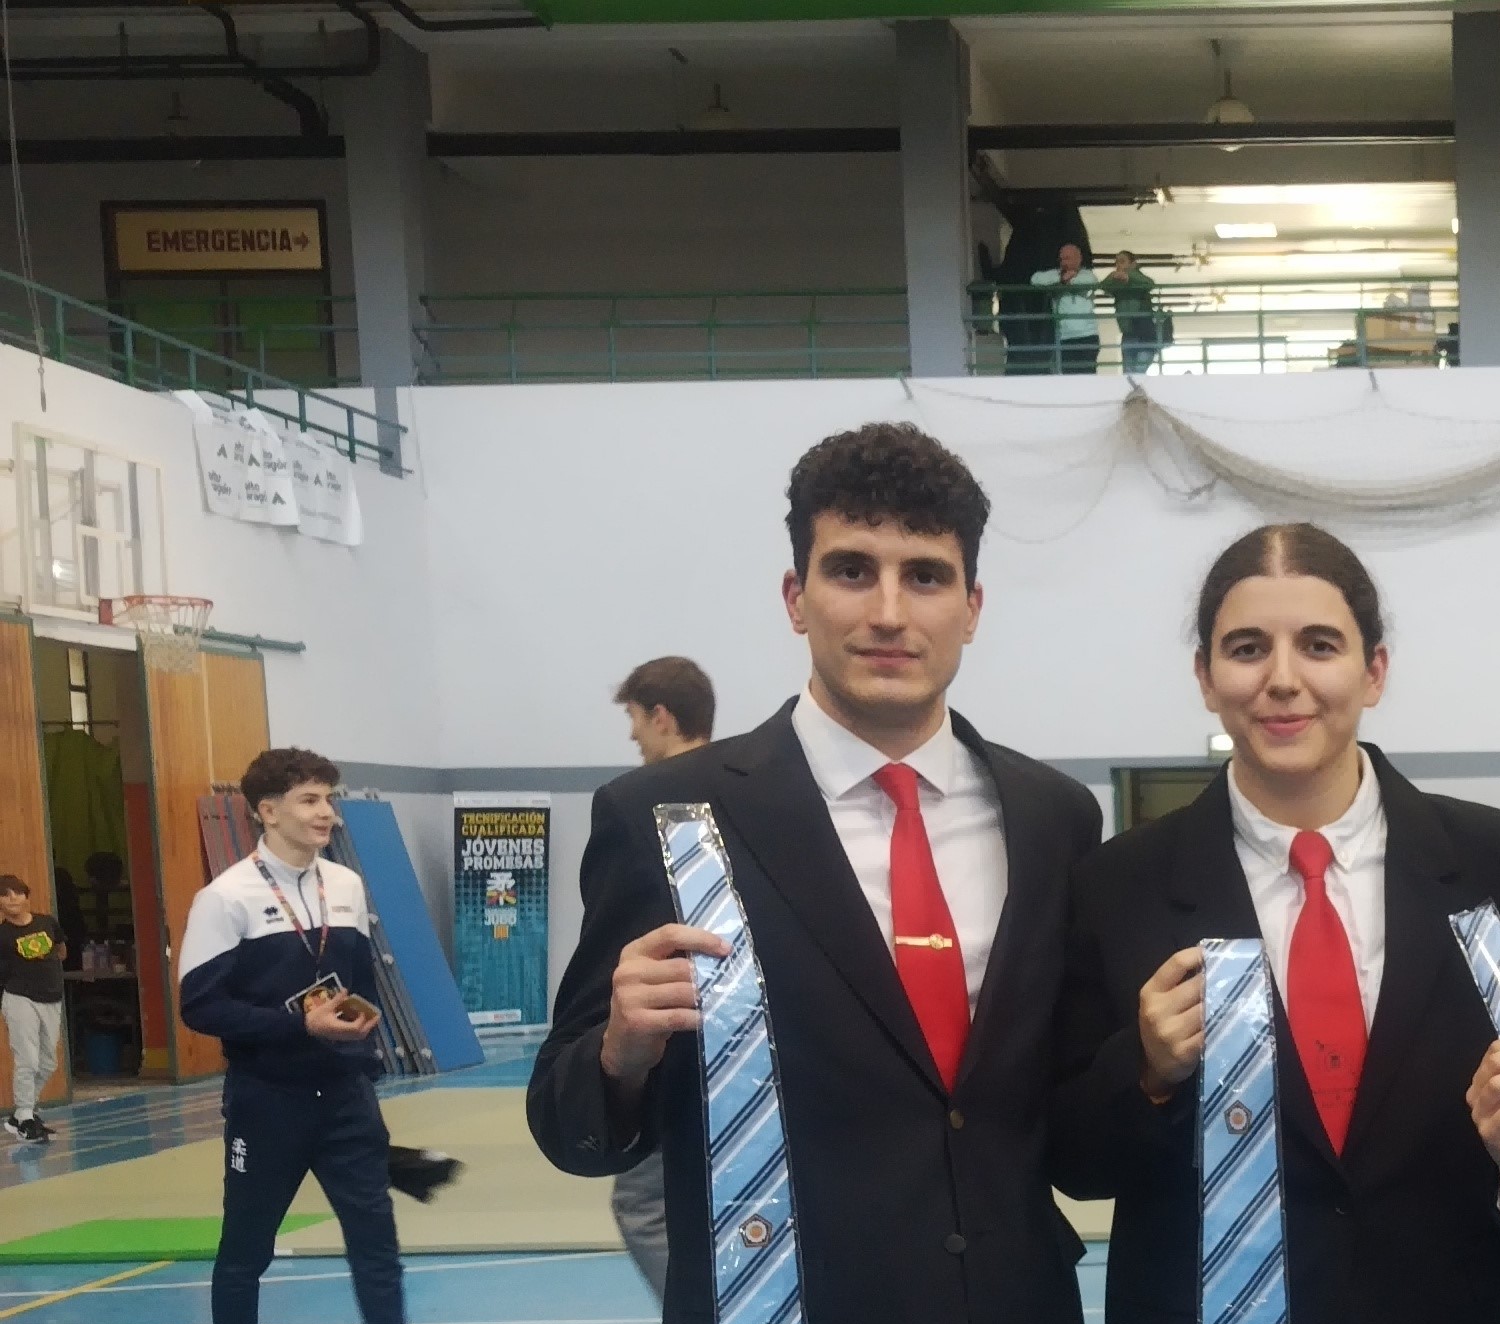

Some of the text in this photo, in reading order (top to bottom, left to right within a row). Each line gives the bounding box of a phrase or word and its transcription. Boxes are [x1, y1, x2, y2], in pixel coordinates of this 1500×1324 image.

[146, 228, 292, 253] EMERGENCIA
[462, 811, 546, 825] TECNIFICACIÓN
[461, 824, 546, 836] CUALIFICADA
[461, 834, 545, 856] JÓVENES
[463, 856, 545, 871] PROMESAS
